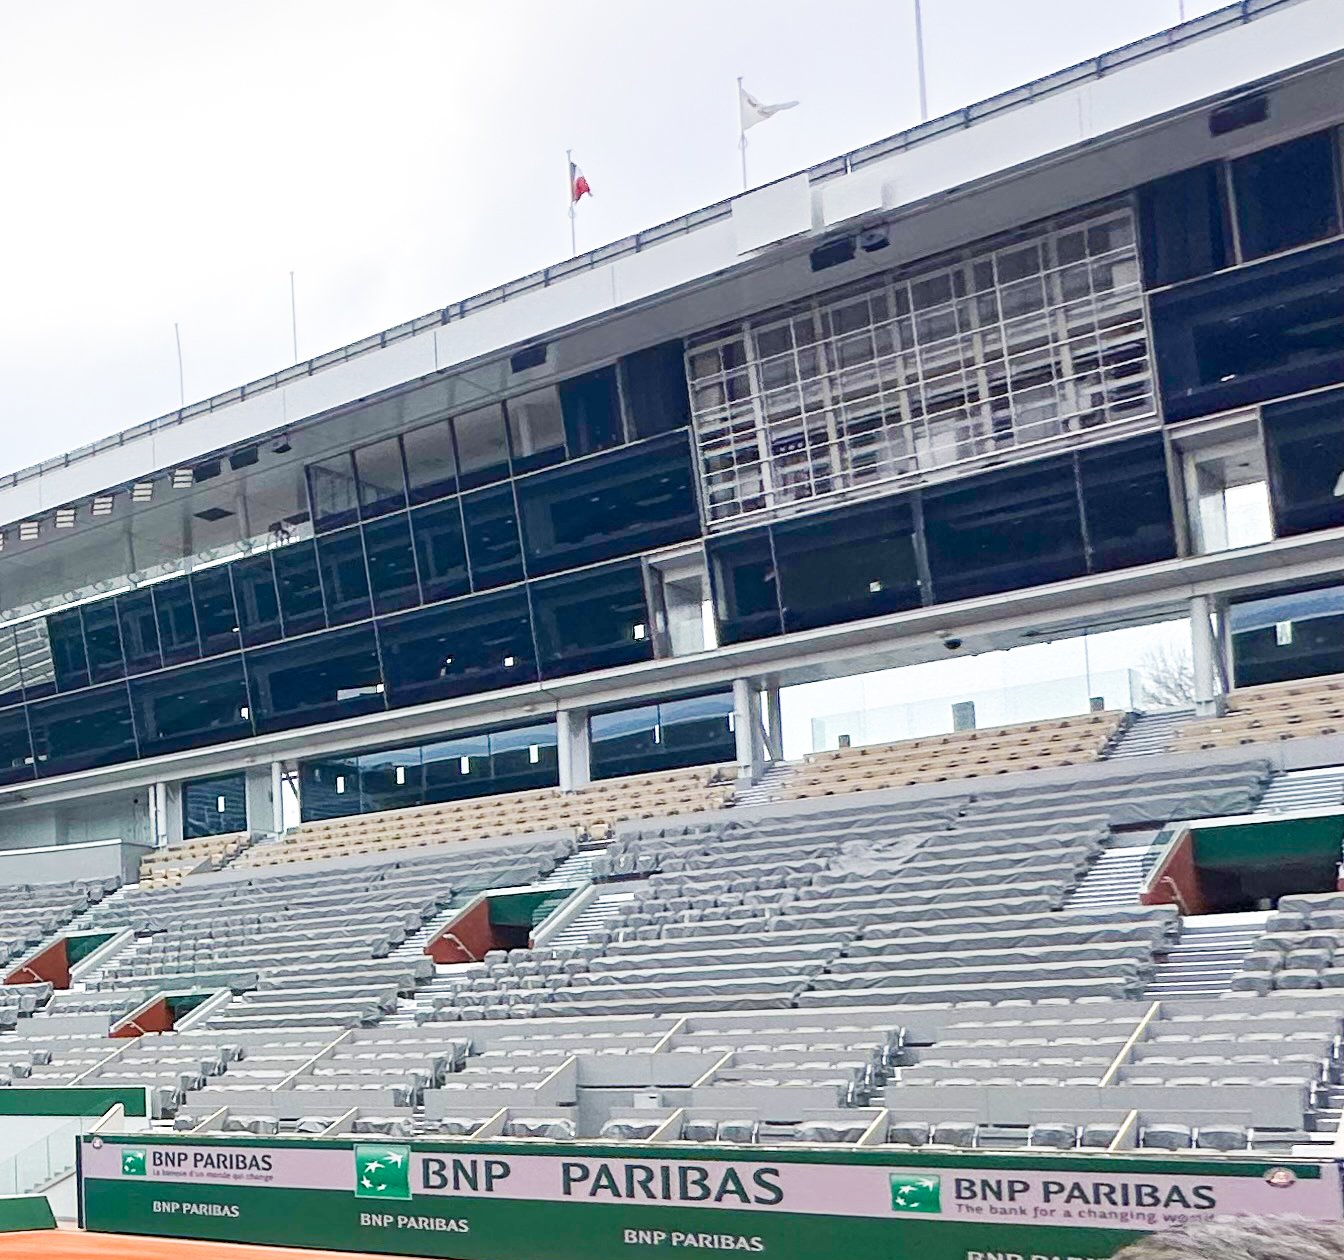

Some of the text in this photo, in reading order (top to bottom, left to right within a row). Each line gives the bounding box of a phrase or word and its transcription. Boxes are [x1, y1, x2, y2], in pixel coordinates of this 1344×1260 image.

[152, 1151, 273, 1171] BNP PARIBAS
[422, 1157, 784, 1205] BNP PARIBAS
[954, 1177, 1217, 1210] BNP PARIBAS
[152, 1200, 240, 1218] BNP PARIBAS
[955, 1203, 983, 1214] The
[989, 1204, 1027, 1217] bank
[1033, 1205, 1056, 1219] for
[1063, 1209, 1073, 1218] a
[1078, 1208, 1158, 1225] changing
[360, 1212, 469, 1233] BNP PARIBAS
[624, 1228, 764, 1252] BNP PARIBAS
